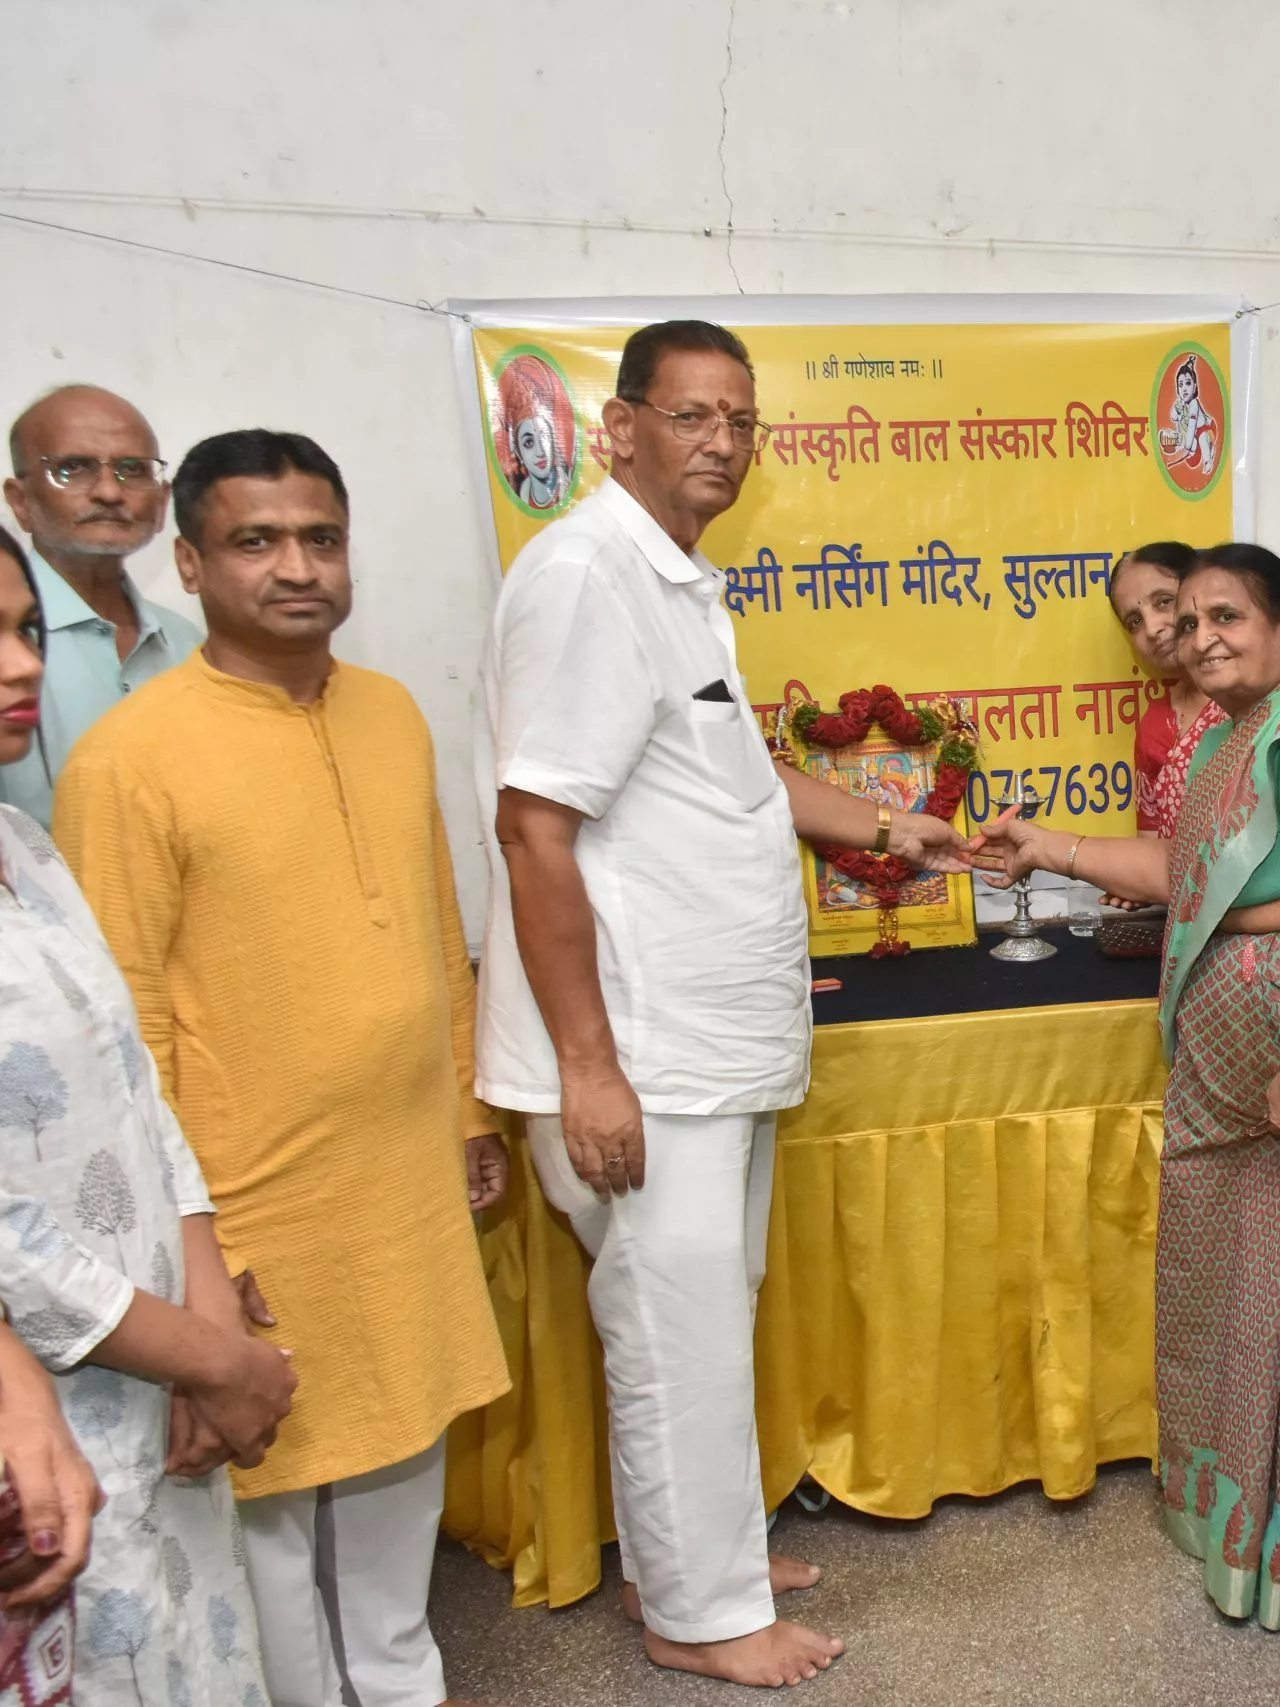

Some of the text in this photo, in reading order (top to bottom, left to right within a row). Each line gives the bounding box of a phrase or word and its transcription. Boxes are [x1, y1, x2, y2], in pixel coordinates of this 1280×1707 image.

[822, 353, 839, 379] श्री
[771, 405, 881, 482] संस्कृति
[888, 420, 951, 463] बाल
[957, 407, 1058, 461] संस्कार
[1064, 400, 1149, 458] शिविर
[717, 547, 784, 618] क्ष्मी
[792, 543, 890, 610] नर्सिंग
[899, 540, 991, 611] मंदिर,
